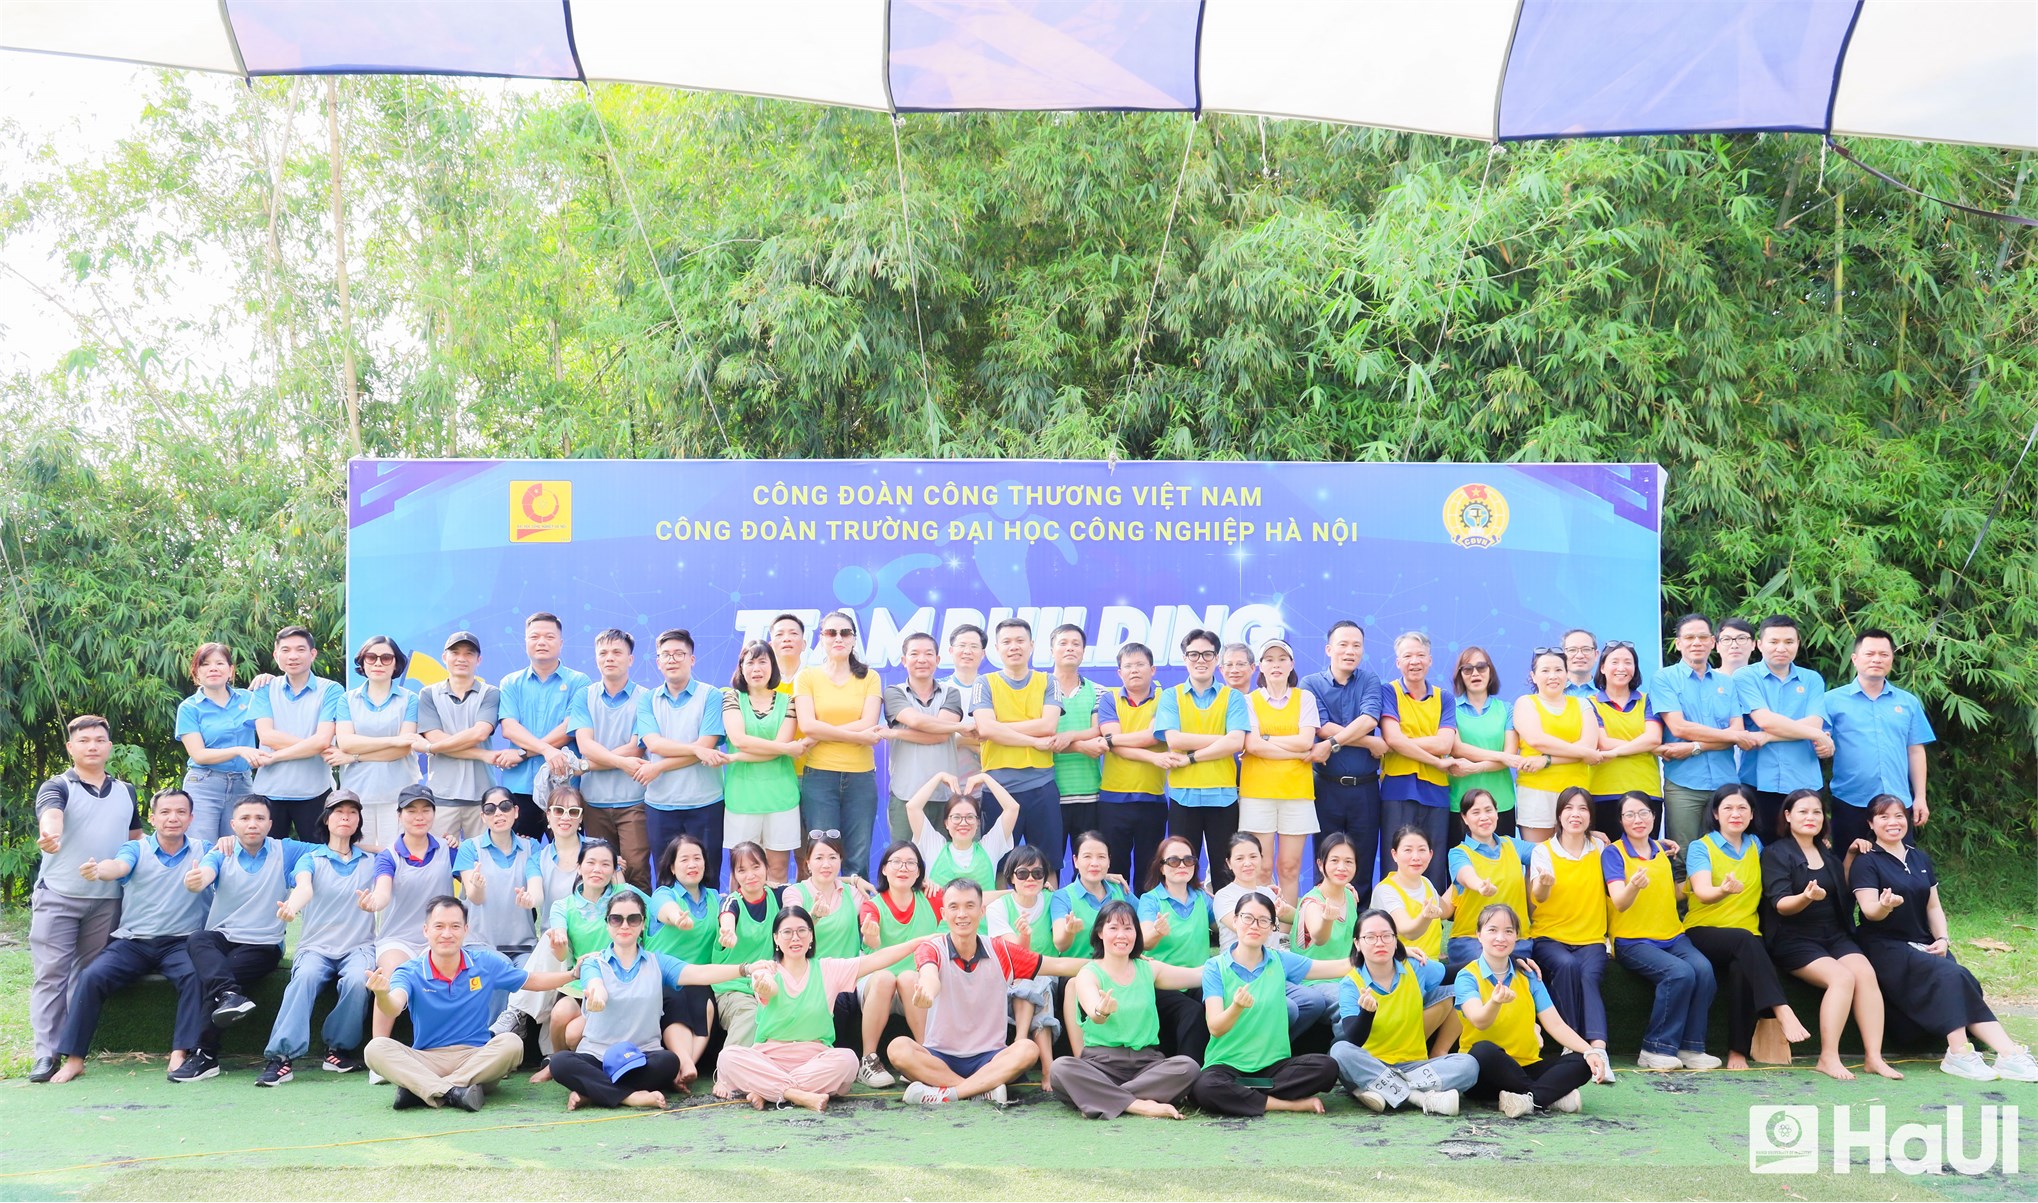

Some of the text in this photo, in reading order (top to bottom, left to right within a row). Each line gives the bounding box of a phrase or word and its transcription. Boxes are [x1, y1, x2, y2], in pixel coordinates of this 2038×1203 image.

[754, 481, 1262, 508] CÔNG ĐOÀN CÔNG THƯƠNG VIỆT NAM
[655, 516, 1358, 546] CÔNG ĐOÀN TRƯỜNG ĐẠI HỌC CÔNG NGHIỆP HÀ NỘI
